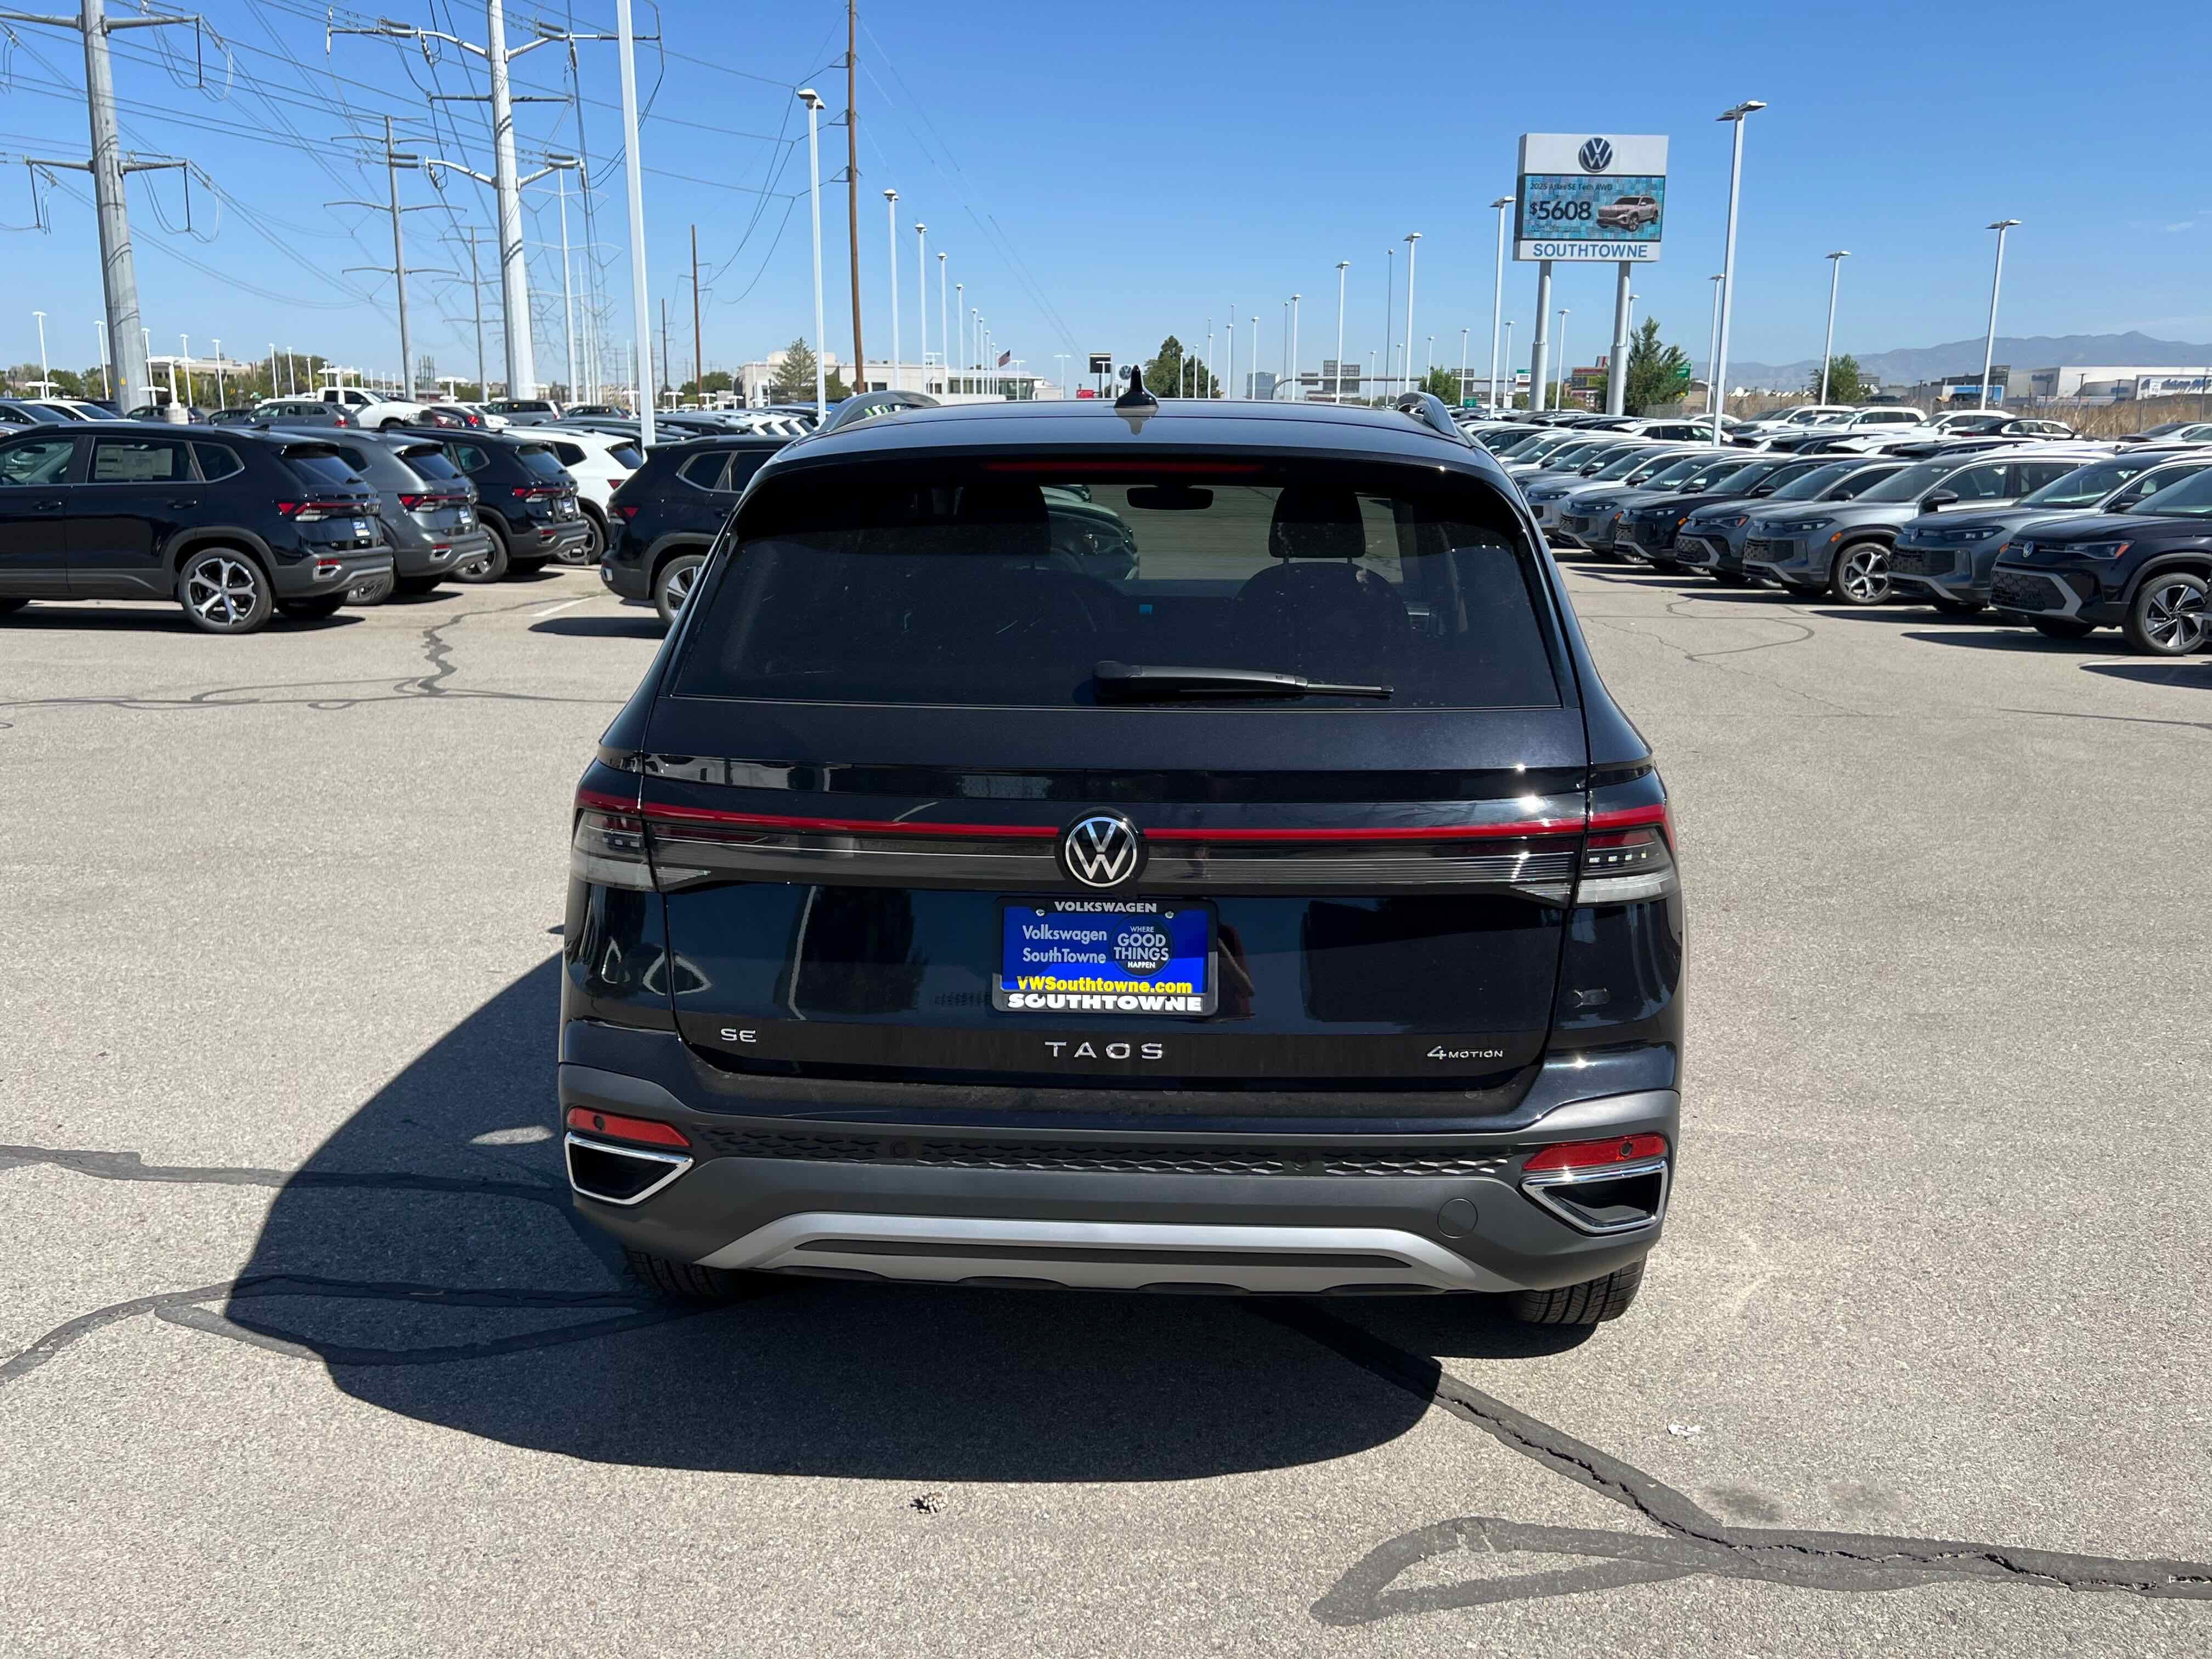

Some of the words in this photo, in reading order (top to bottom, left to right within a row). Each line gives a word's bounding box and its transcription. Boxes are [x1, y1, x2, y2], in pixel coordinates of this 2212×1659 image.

[1529, 201, 1592, 221] $5608
[1533, 243, 1647, 258] SOUTHTOWNE
[1066, 818, 1136, 885] VW
[1054, 901, 1157, 913] VOLKSWAGEN
[1023, 924, 1107, 945] Volkswagen
[1117, 933, 1166, 947] GOOD
[1023, 947, 1107, 964] SouthTowne
[1114, 946, 1169, 961] THINGS
[1007, 993, 1203, 1012] SOUTHTOWNE
[720, 1028, 757, 1043] SE
[1045, 1041, 1163, 1059] TAOS
[1426, 1045, 1504, 1060] 4MOTION
